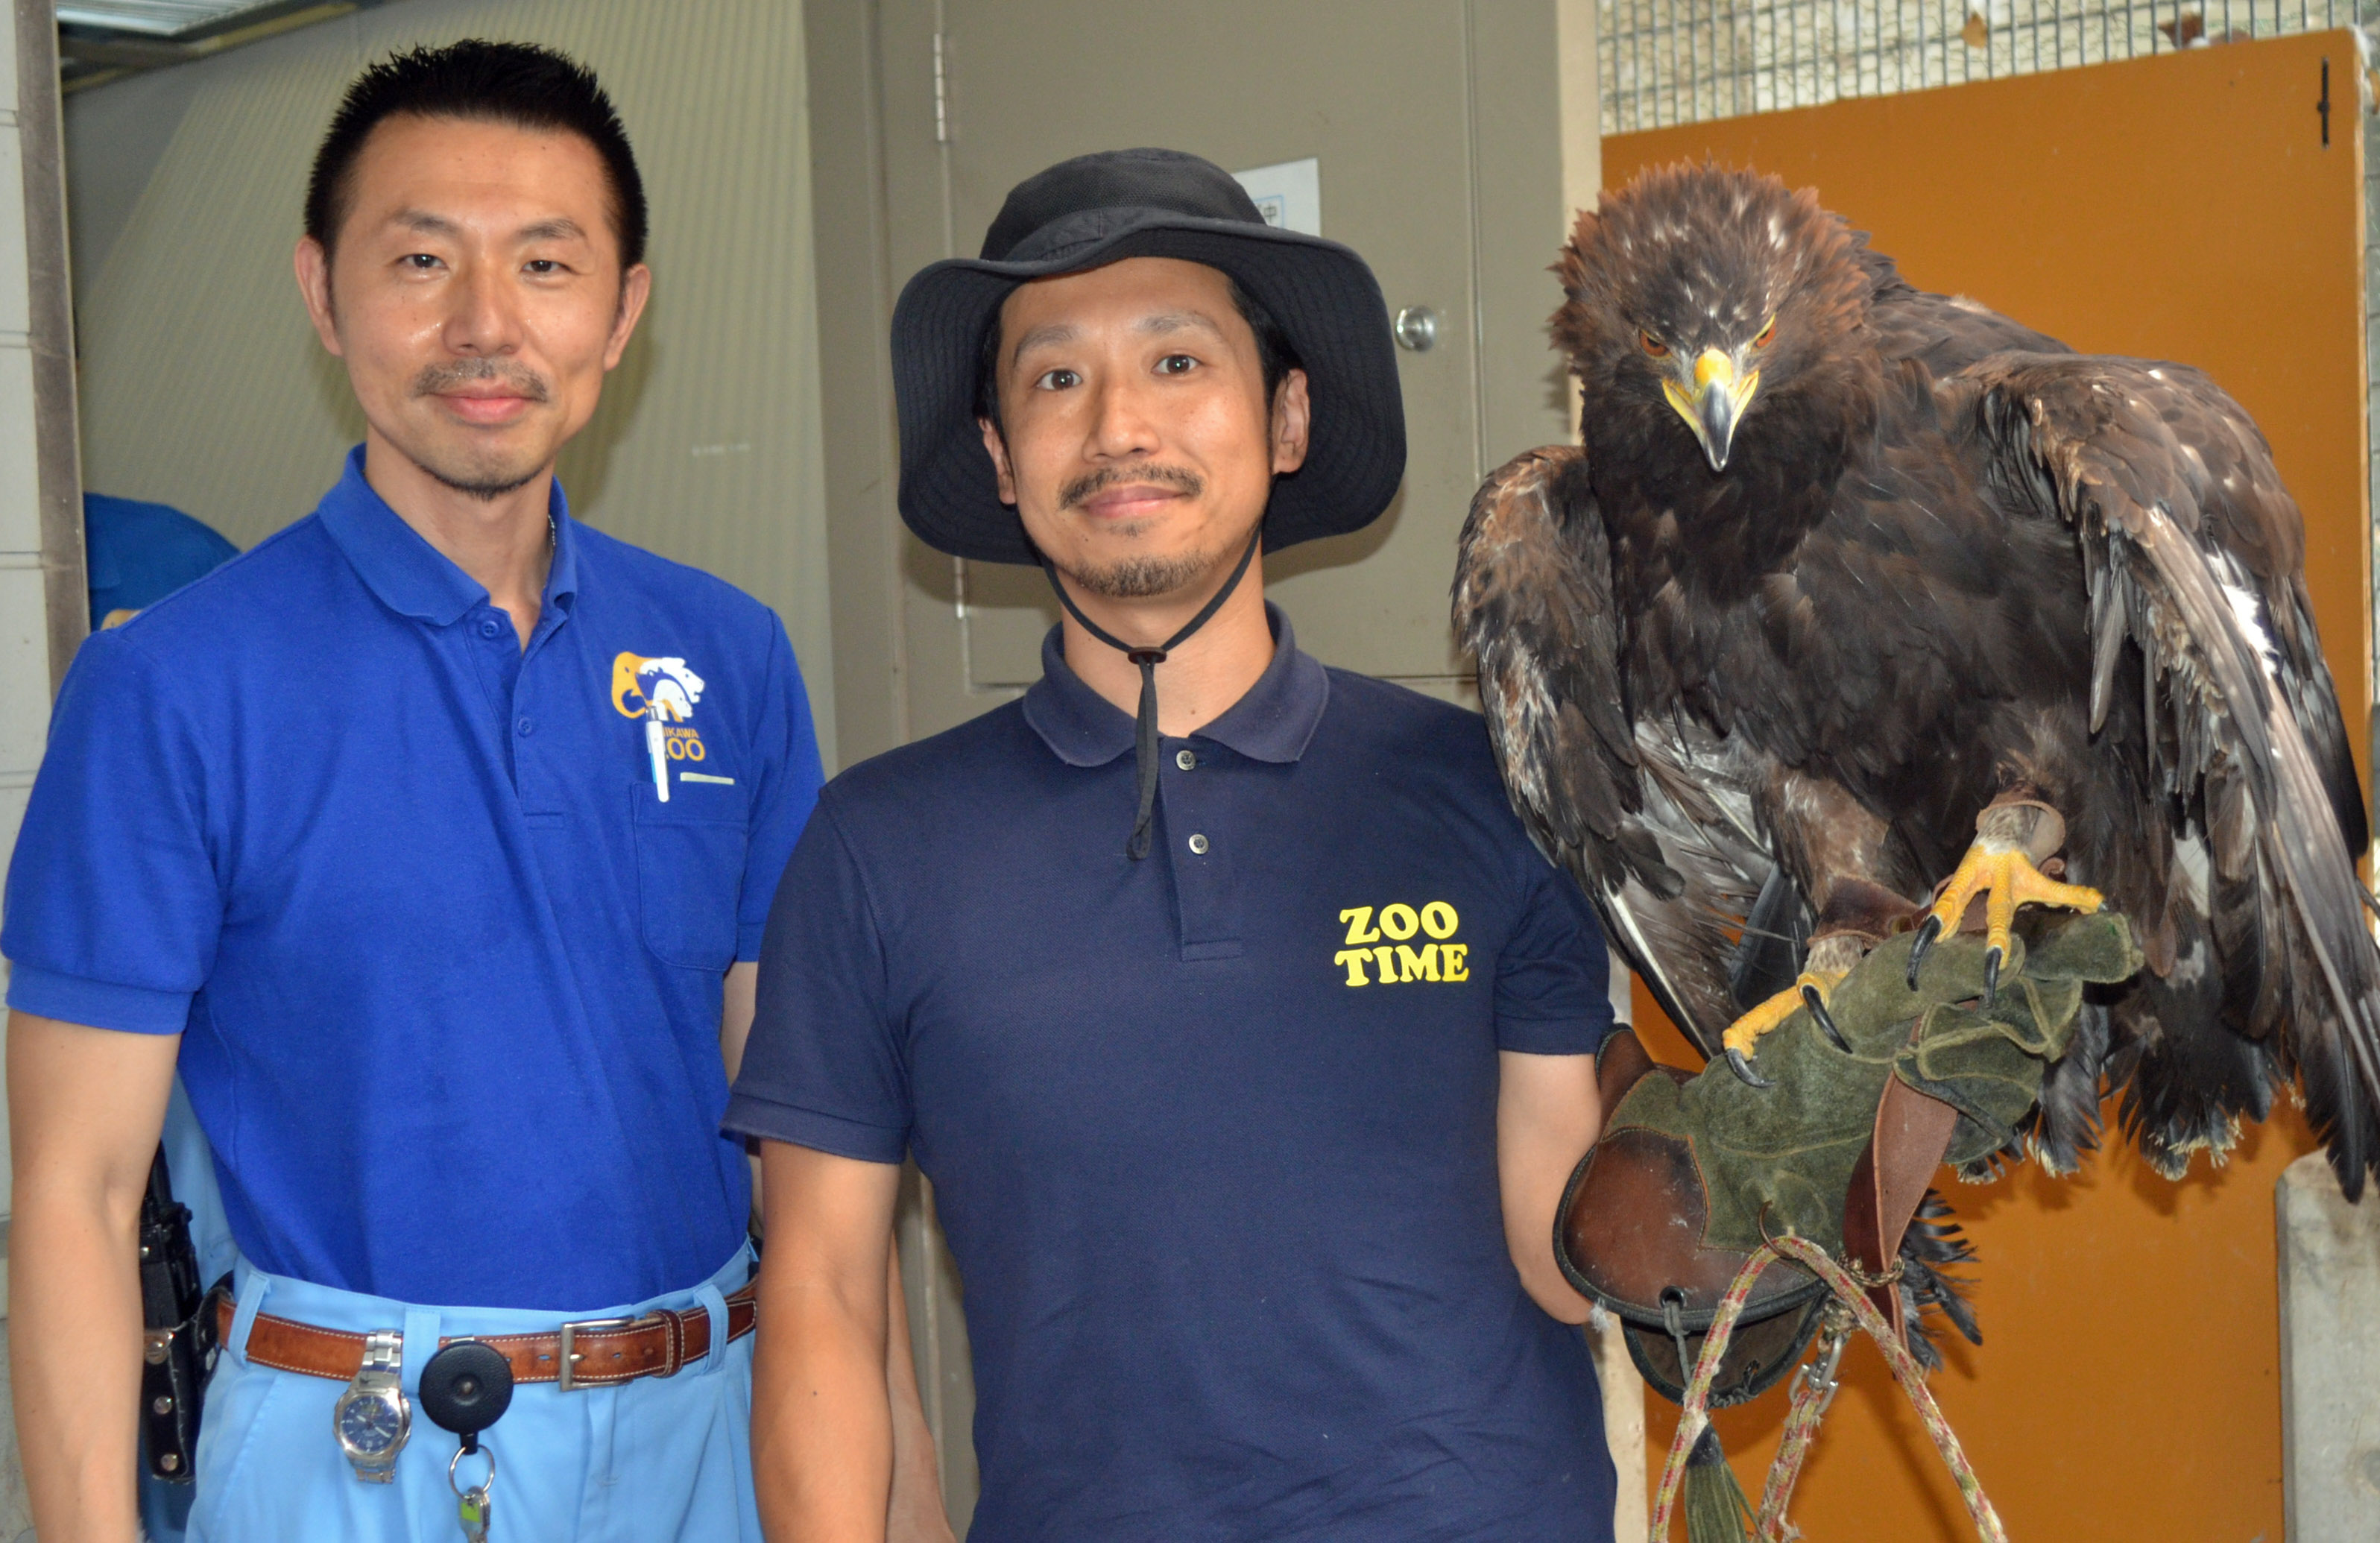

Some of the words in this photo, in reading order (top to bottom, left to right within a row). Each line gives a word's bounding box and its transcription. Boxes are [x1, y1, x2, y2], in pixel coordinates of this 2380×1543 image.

[1258, 202, 1277, 222] 中
[663, 727, 699, 739] IKAWA
[666, 738, 705, 761] OO
[1339, 900, 1459, 945] ZOO
[1334, 943, 1469, 987] TIME
